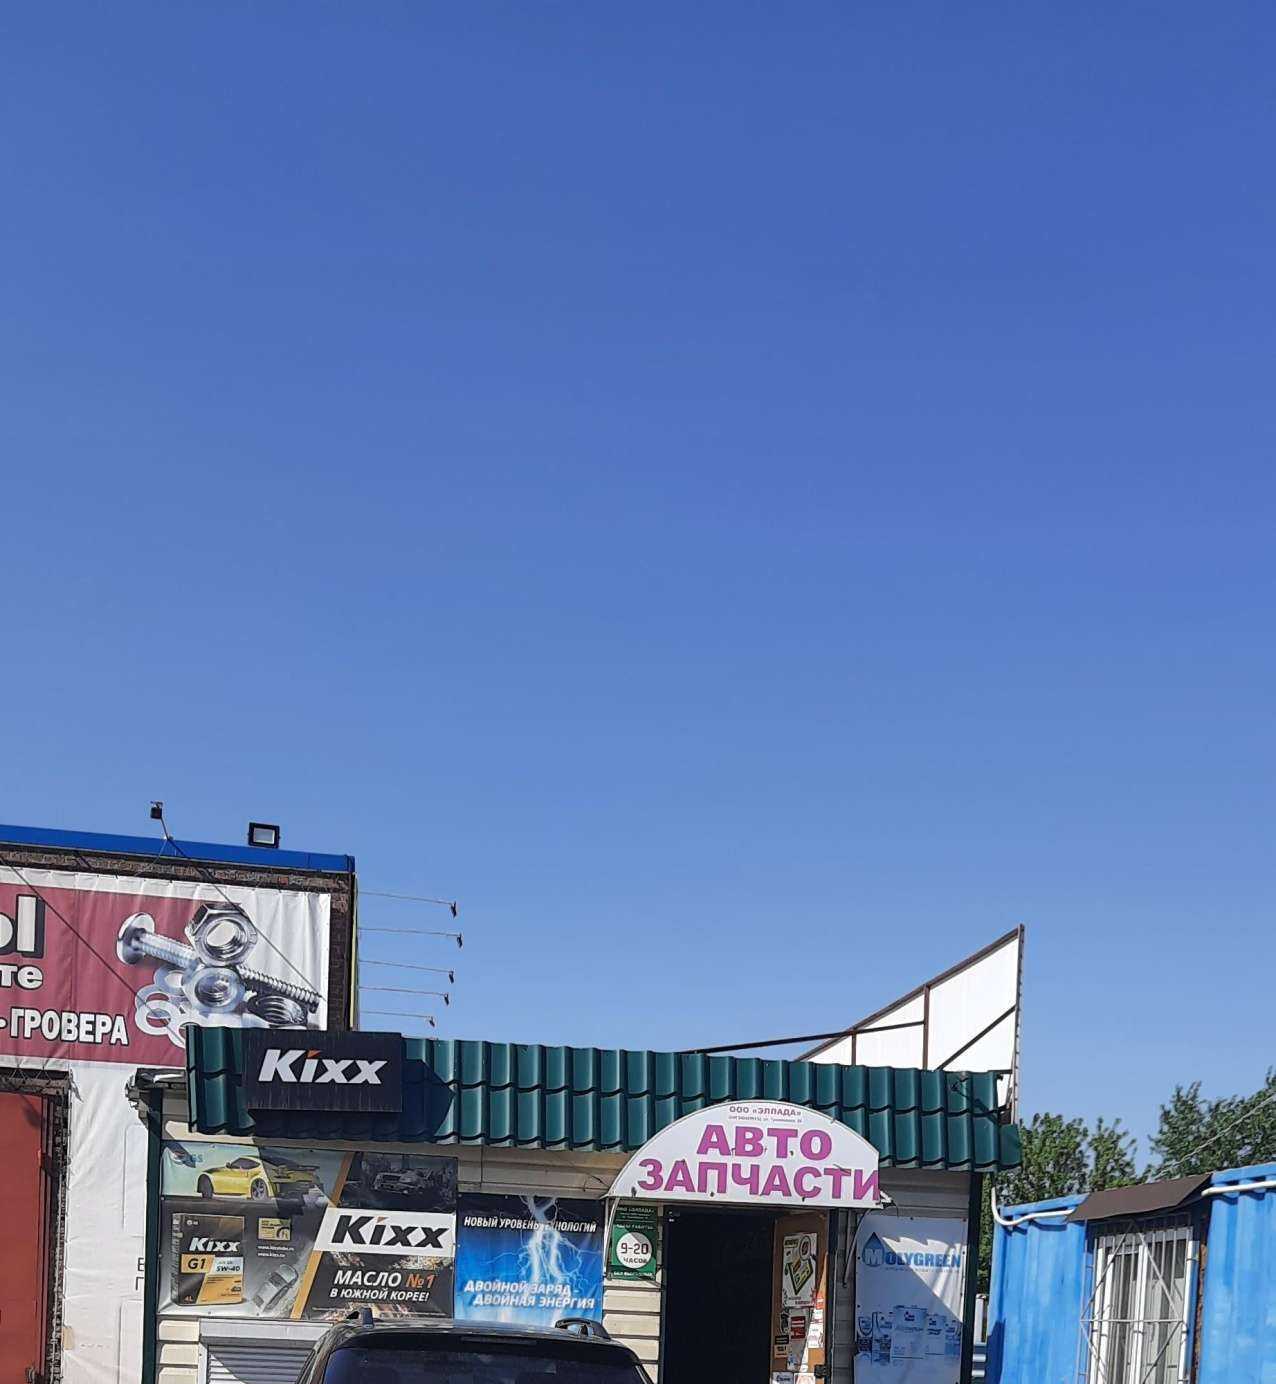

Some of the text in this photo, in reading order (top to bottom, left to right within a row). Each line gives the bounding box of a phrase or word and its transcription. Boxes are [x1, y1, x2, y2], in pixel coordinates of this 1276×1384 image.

[10, 1007, 129, 1046] ГРОВЕРА
[258, 1049, 388, 1085] Kixx
[696, 1124, 833, 1161] АВТО
[637, 1158, 880, 1201] ЗАПЧАСТИ
[331, 1214, 450, 1249] Kixx
[464, 1215, 498, 1228] НОВЫЙ
[499, 1218, 539, 1231] УРОВЕНЬ
[188, 1237, 241, 1252] Kixx
[620, 1242, 649, 1255] 9-20
[187, 1257, 206, 1270] G1
[334, 1270, 402, 1288] МАСЛО
[464, 1279, 528, 1293] ДВОЙНОЙ
[530, 1283, 571, 1296] ЗАРЯД
[330, 1286, 430, 1302] В ЮЖНОЙ КОРЕЕ!
[473, 1293, 596, 1309] ДВОЙНАЯ ЭНЕРГИЯ
